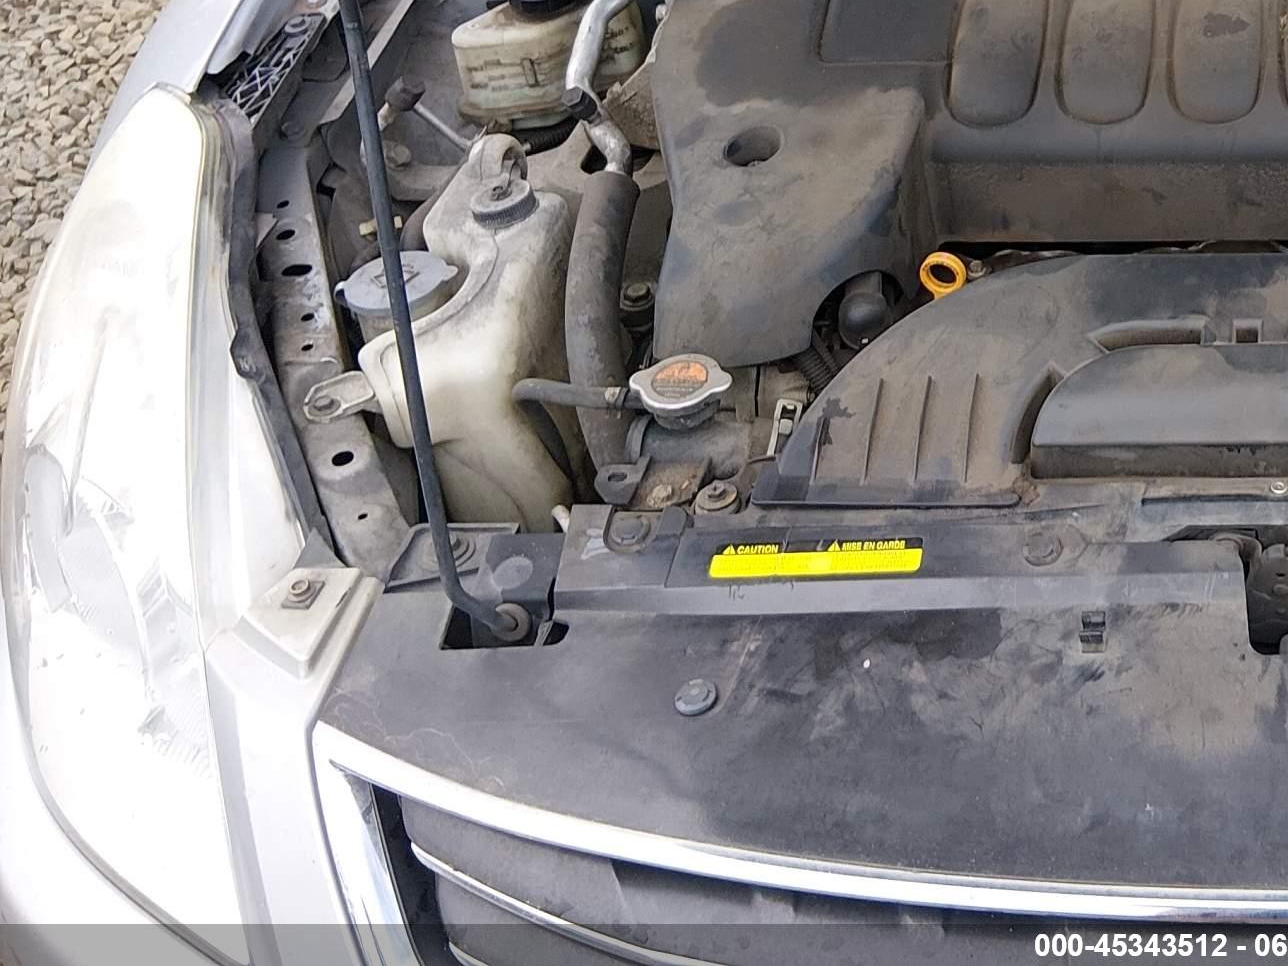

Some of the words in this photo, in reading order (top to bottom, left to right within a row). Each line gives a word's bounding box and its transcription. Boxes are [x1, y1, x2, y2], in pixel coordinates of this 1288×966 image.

[737, 545, 779, 554] CAUTION
[841, 541, 862, 551] MISE
[863, 541, 875, 550] EN
[876, 540, 906, 550] GARDE
